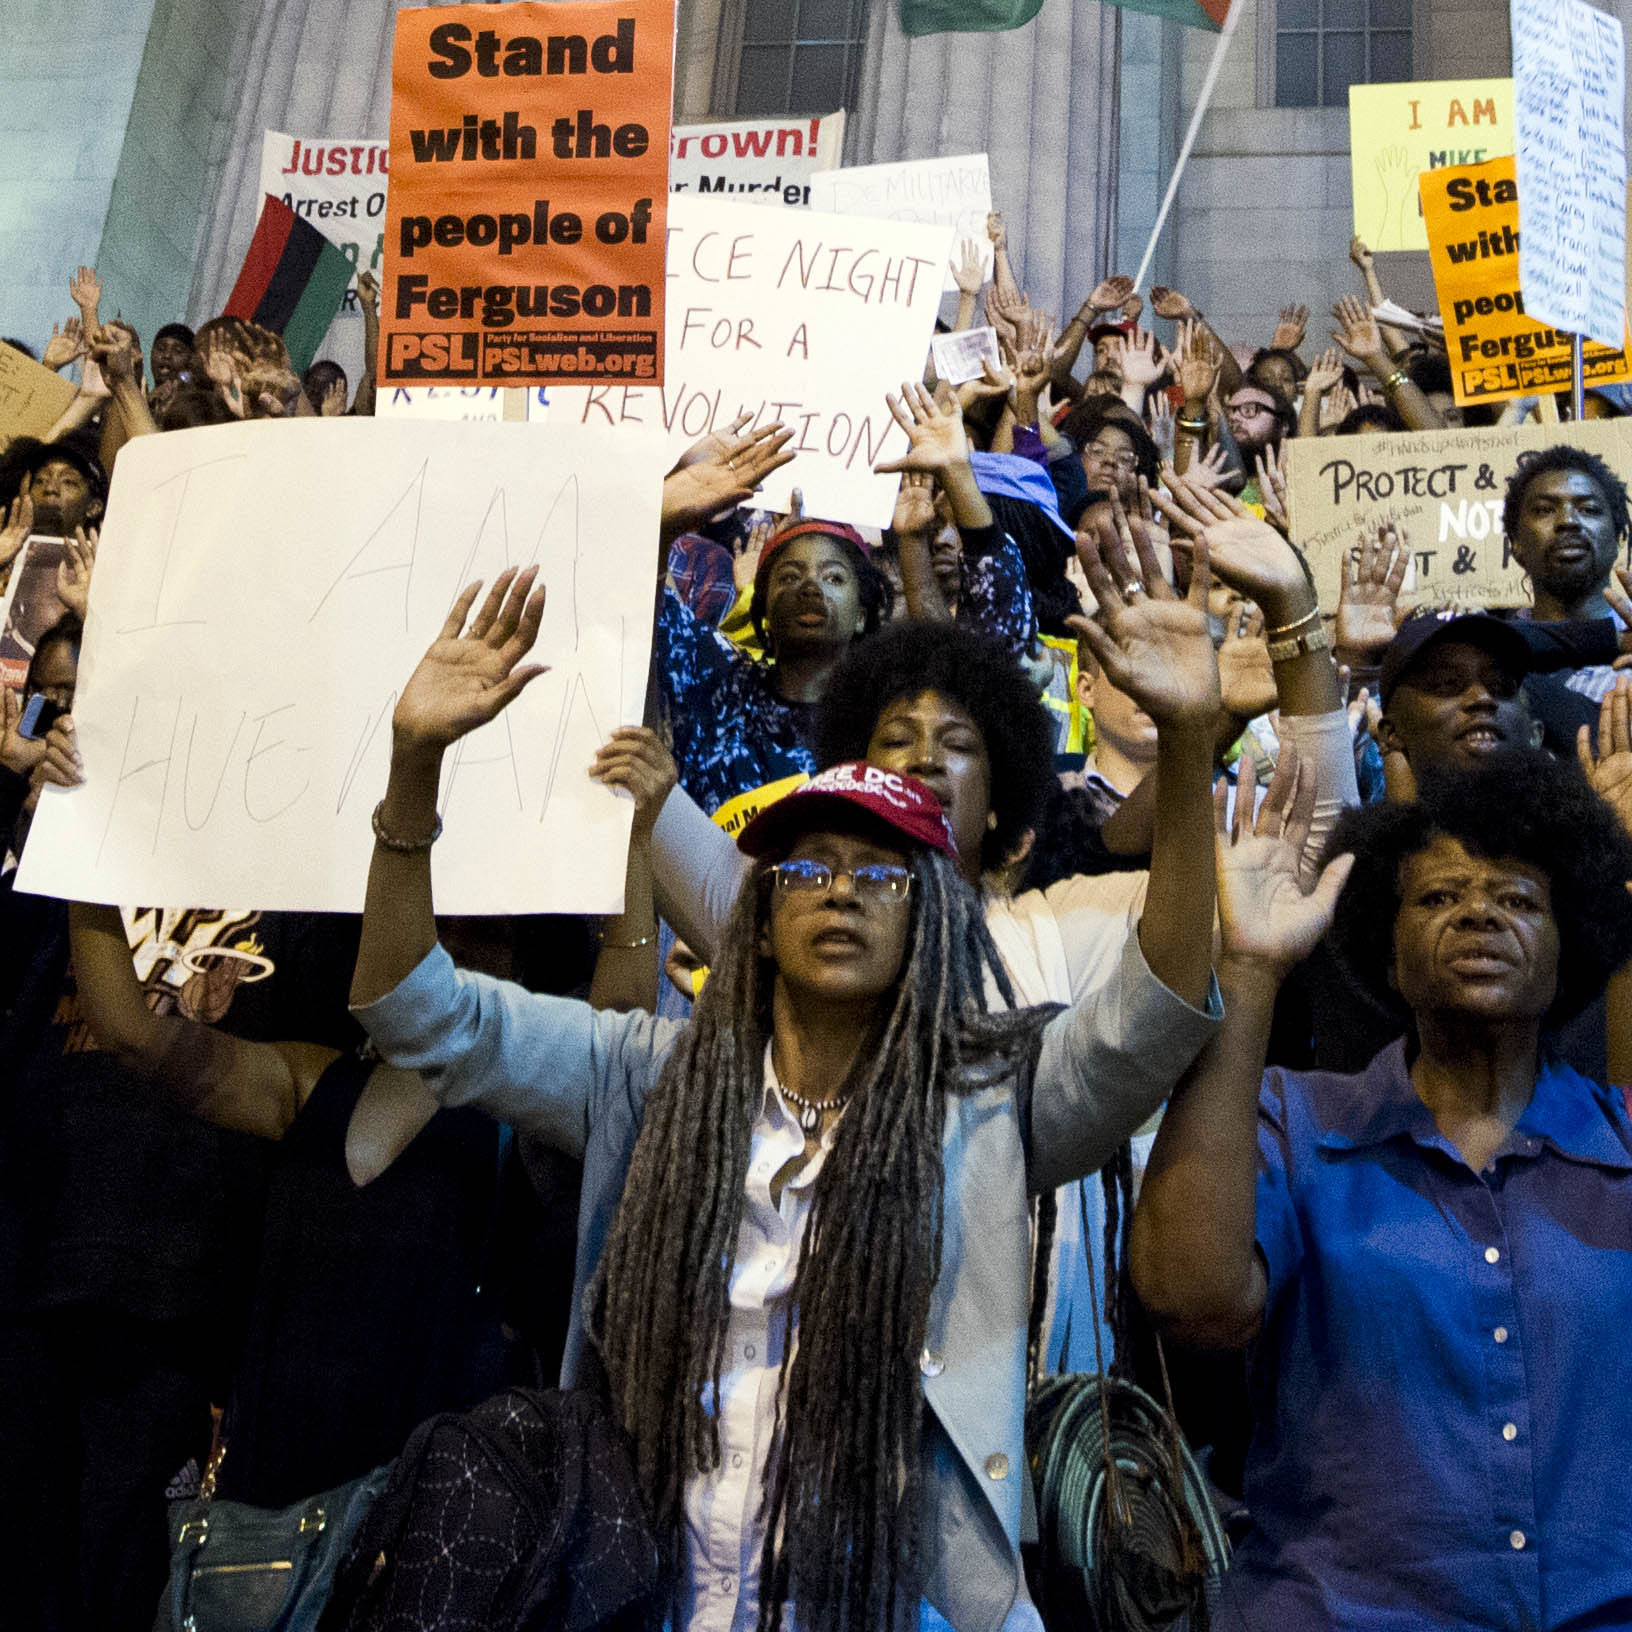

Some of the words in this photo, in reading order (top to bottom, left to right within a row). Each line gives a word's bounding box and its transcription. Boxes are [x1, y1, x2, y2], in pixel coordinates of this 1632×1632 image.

[428, 18, 635, 79] Stand
[410, 111, 536, 163] with
[552, 110, 649, 159] the
[1408, 100, 1421, 130] I
[1448, 98, 1498, 127] AM
[282, 140, 389, 175] Justic
[668, 119, 821, 159] rown!
[282, 192, 359, 219] Arrest
[366, 192, 385, 218] O
[1446, 177, 1519, 213] Sta
[400, 200, 583, 258] people
[595, 198, 653, 246] of
[776, 239, 936, 308] NIGHT
[396, 274, 652, 328] Ferguson
[391, 333, 474, 372] PSL
[484, 346, 656, 378] PSLweb.org
[680, 307, 763, 351] FOR
[787, 323, 809, 361] A
[1460, 328, 1574, 363] Fergus
[1463, 364, 1517, 394] PSL
[1521, 358, 1627, 387] PSLwb.org
[1319, 459, 1468, 506] PROTECT
[1474, 463, 1498, 491] &
[114, 452, 250, 637] I
[1452, 544, 1477, 575] &
